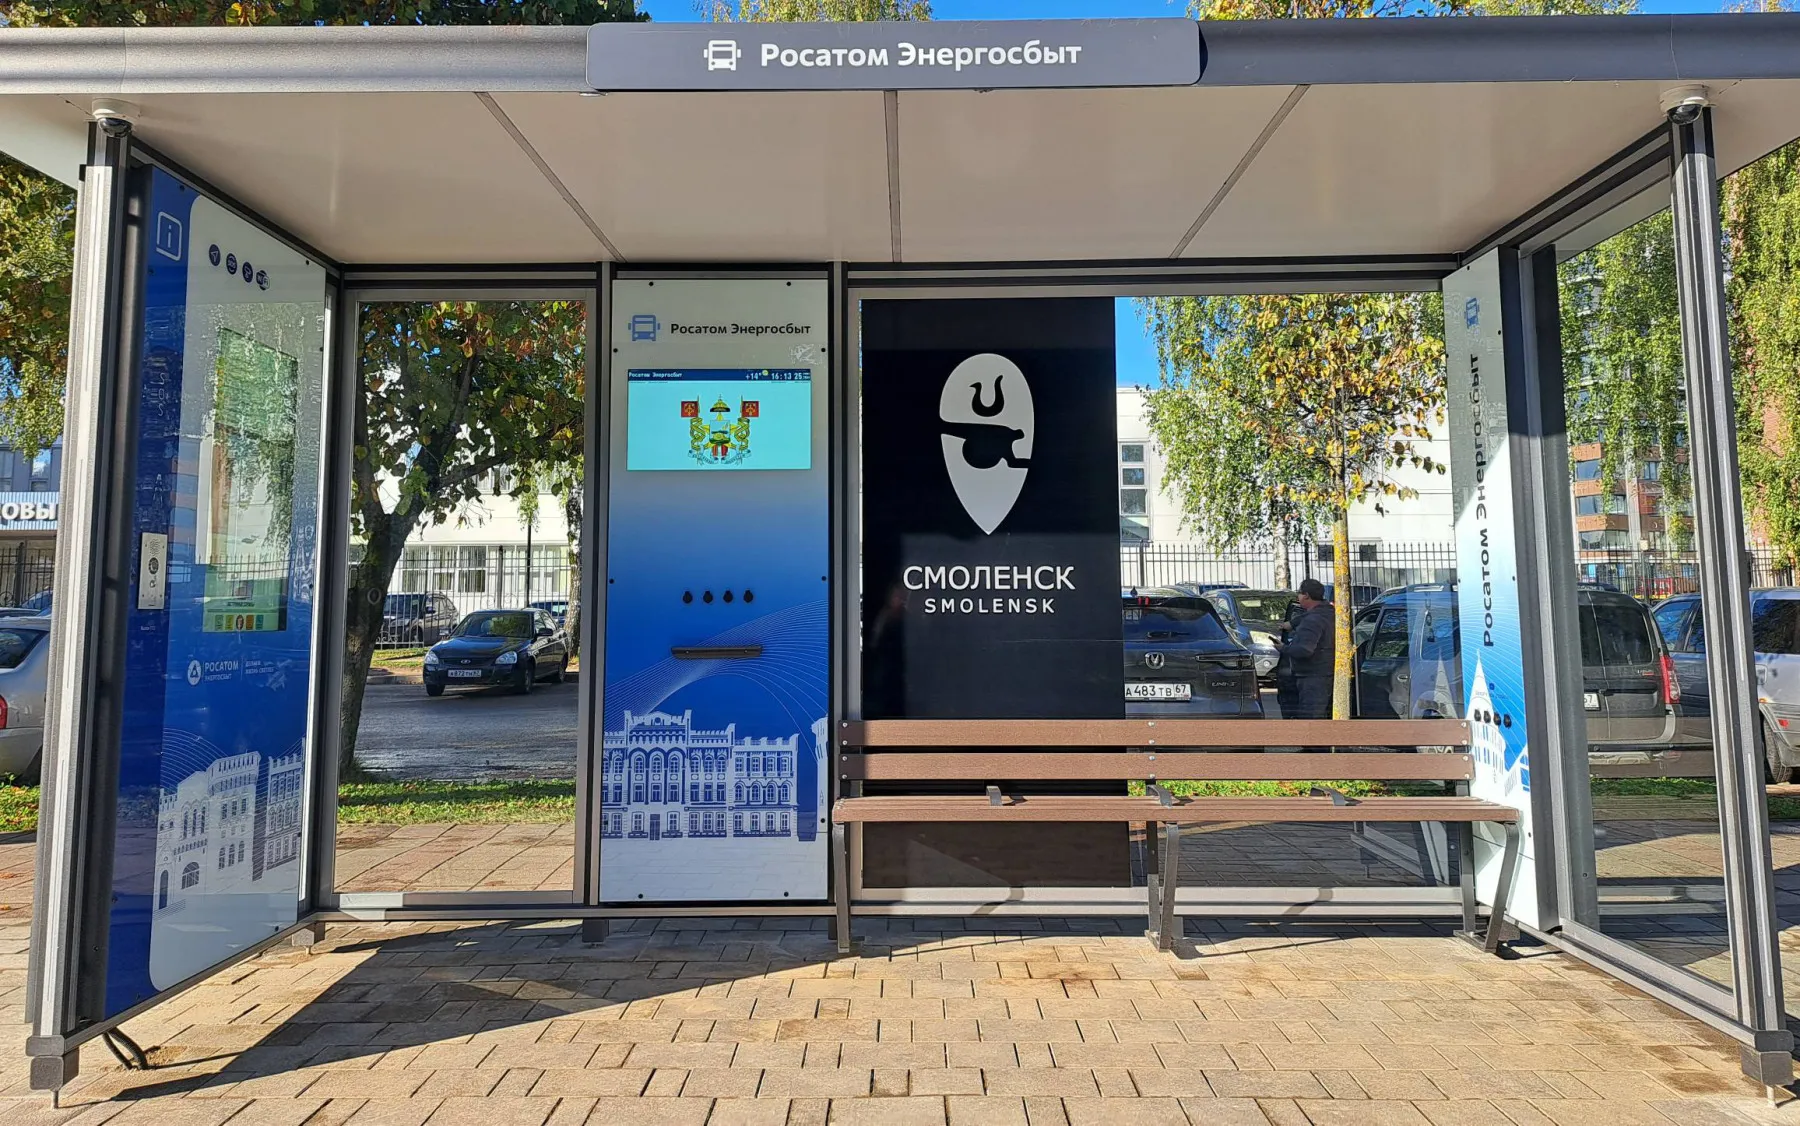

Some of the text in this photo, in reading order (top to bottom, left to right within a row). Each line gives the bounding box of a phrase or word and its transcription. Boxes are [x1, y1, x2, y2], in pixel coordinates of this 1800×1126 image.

[761, 40, 1082, 71] Росатом Энергосбыт
[670, 322, 811, 337] Росатом Энергосбыт
[771, 372, 792, 380] 16:13
[793, 372, 803, 380] 25
[1, 502, 57, 520] ОВЫ
[903, 565, 1076, 590] СМОЛЕНСК
[1479, 528, 1494, 647] Росатом
[924, 598, 1055, 614] SMOLENSK
[204, 660, 239, 672] РОСАТОМ
